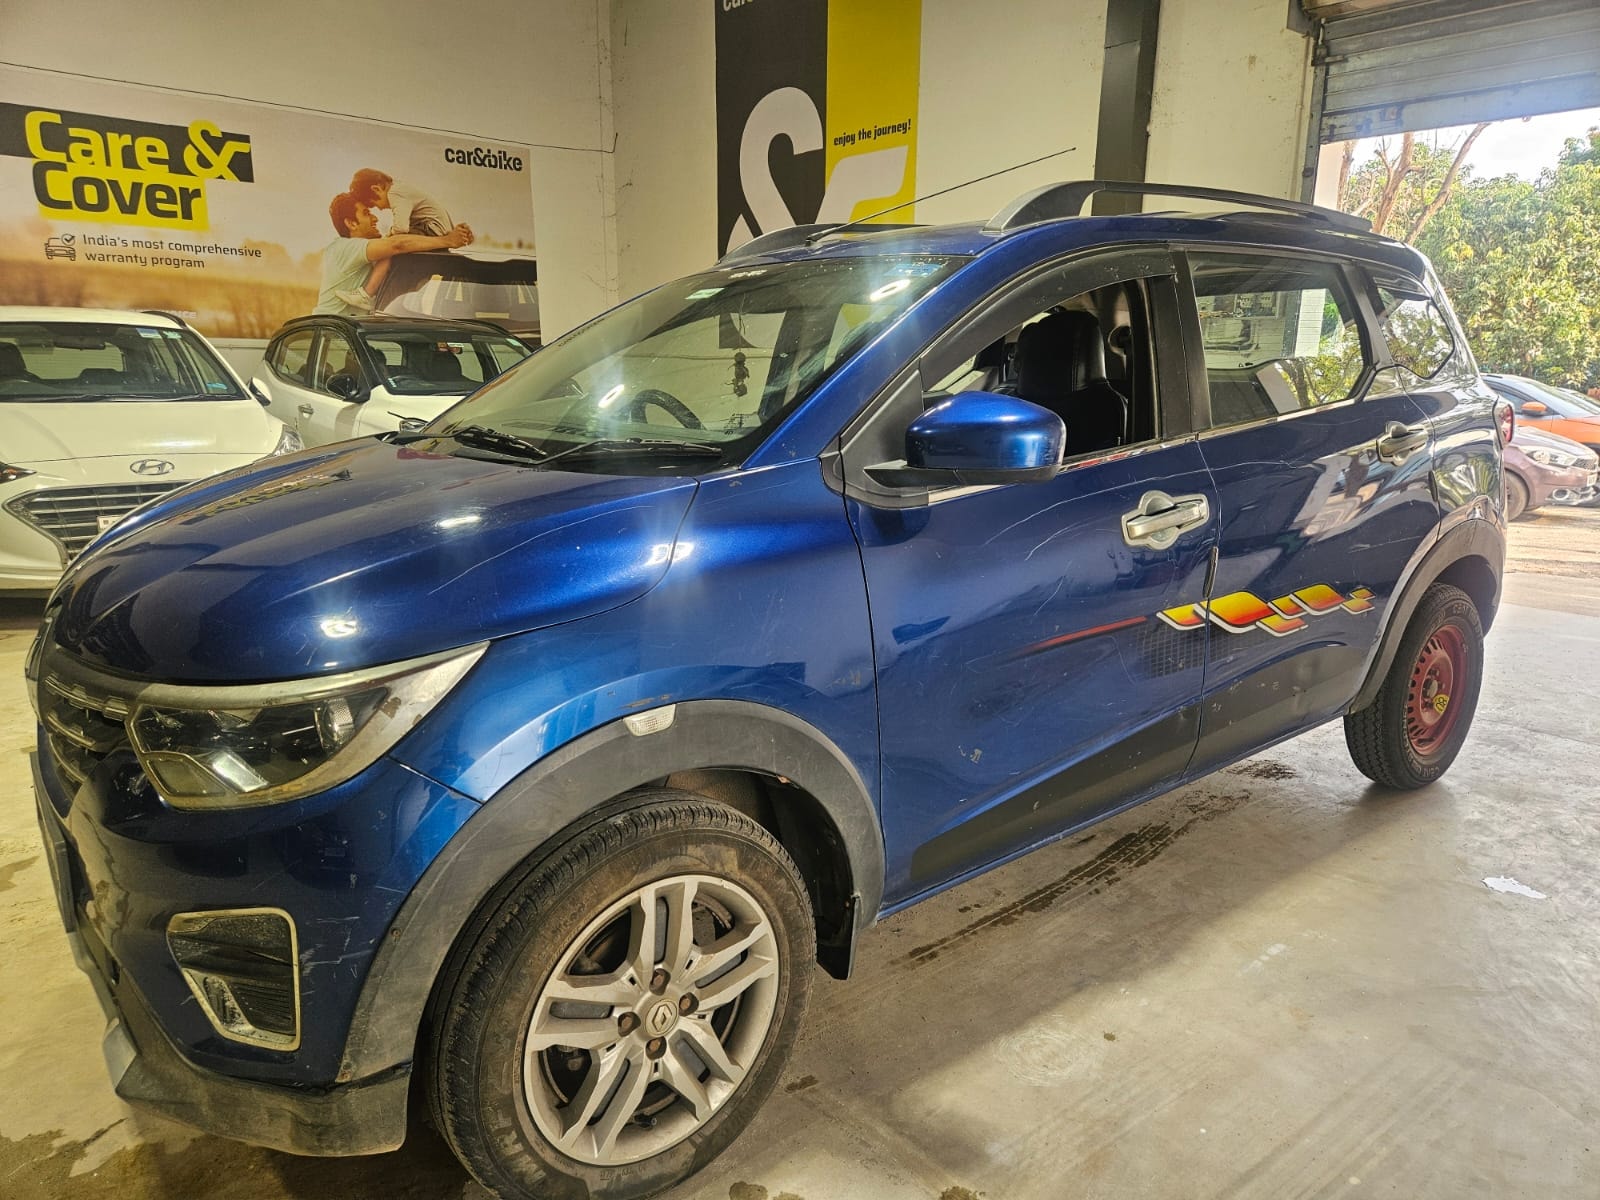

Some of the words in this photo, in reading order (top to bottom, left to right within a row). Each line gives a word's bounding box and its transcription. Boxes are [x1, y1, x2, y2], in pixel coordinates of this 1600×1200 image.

[25, 110, 169, 173] Care
[184, 119, 251, 181] &
[833, 132, 856, 147] enjoy
[858, 128, 872, 141] the
[874, 118, 911, 140] journey!
[445, 147, 523, 172] car&bike
[32, 160, 202, 221] Cover
[83, 234, 128, 248] India's
[132, 239, 164, 250] most
[168, 240, 262, 258] comprehensive
[85, 252, 148, 267] warranty
[151, 254, 205, 269] program
